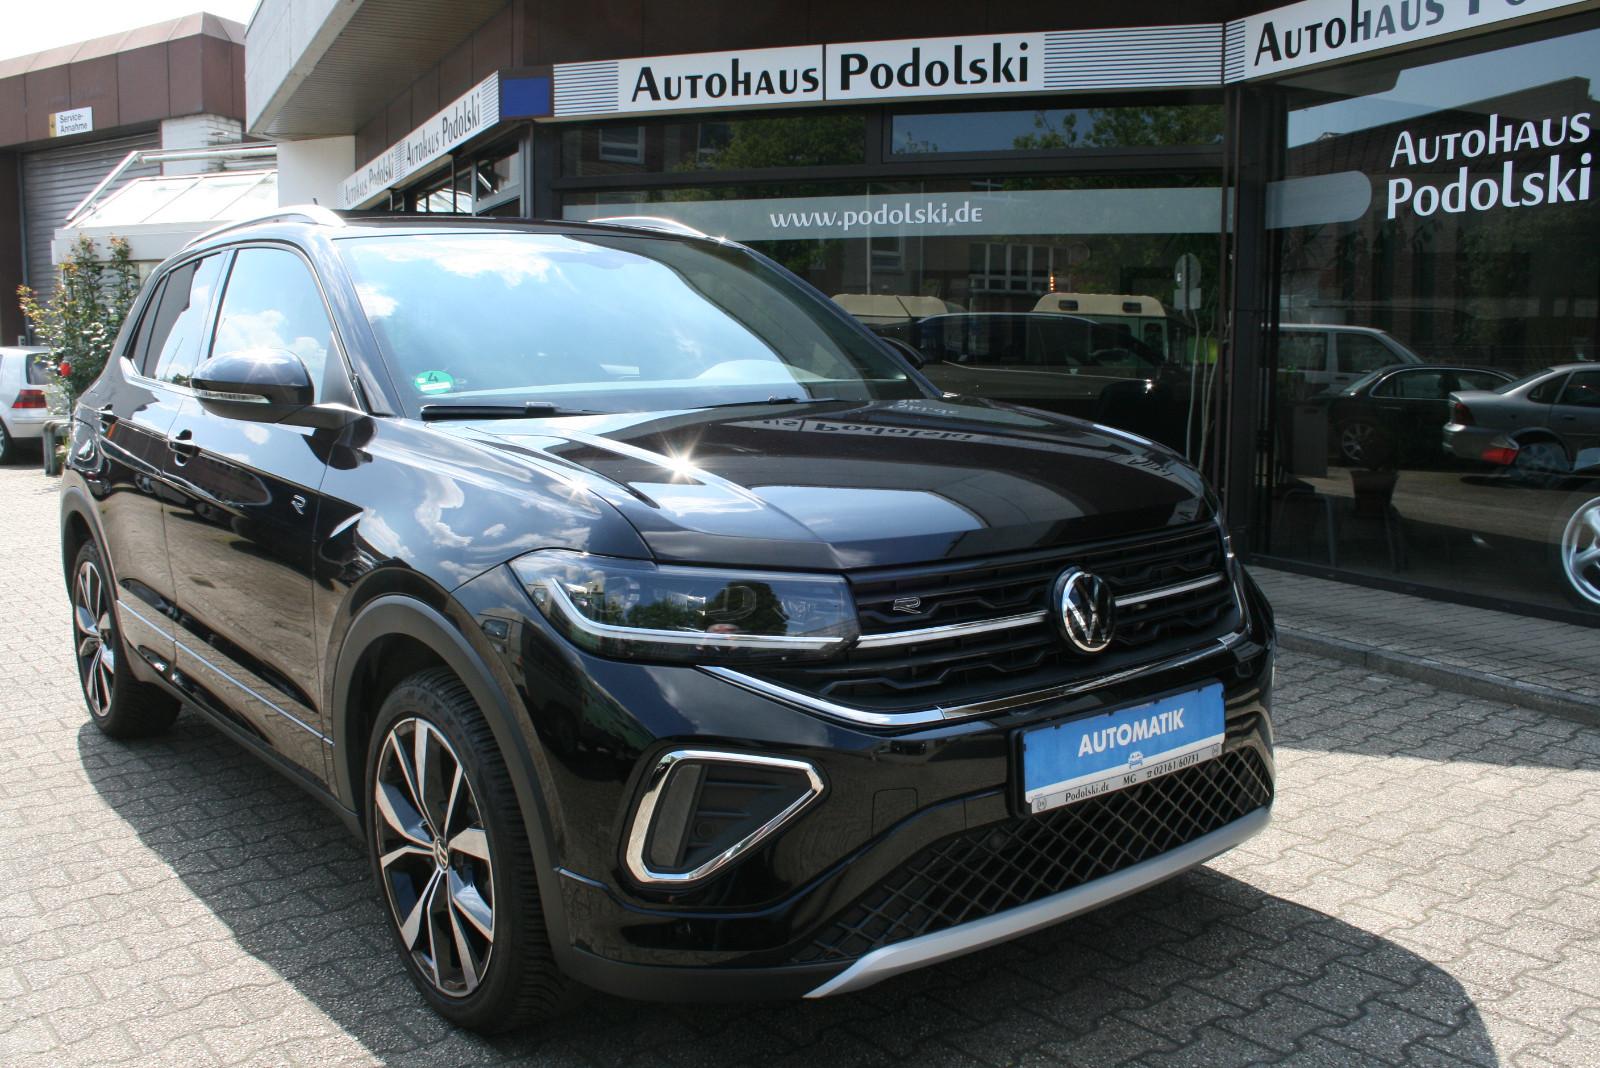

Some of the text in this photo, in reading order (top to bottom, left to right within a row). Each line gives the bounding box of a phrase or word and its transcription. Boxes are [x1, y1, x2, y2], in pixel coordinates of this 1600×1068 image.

[840, 42, 1029, 91] Podolski
[61, 122, 88, 132] Annahme
[443, 93, 480, 145] Podolski
[369, 153, 394, 185] Podolski
[1387, 152, 1592, 219] Podolski
[427, 372, 439, 383] 4
[1079, 709, 1184, 756] AUTOMATIK
[1123, 773, 1137, 785] MG
